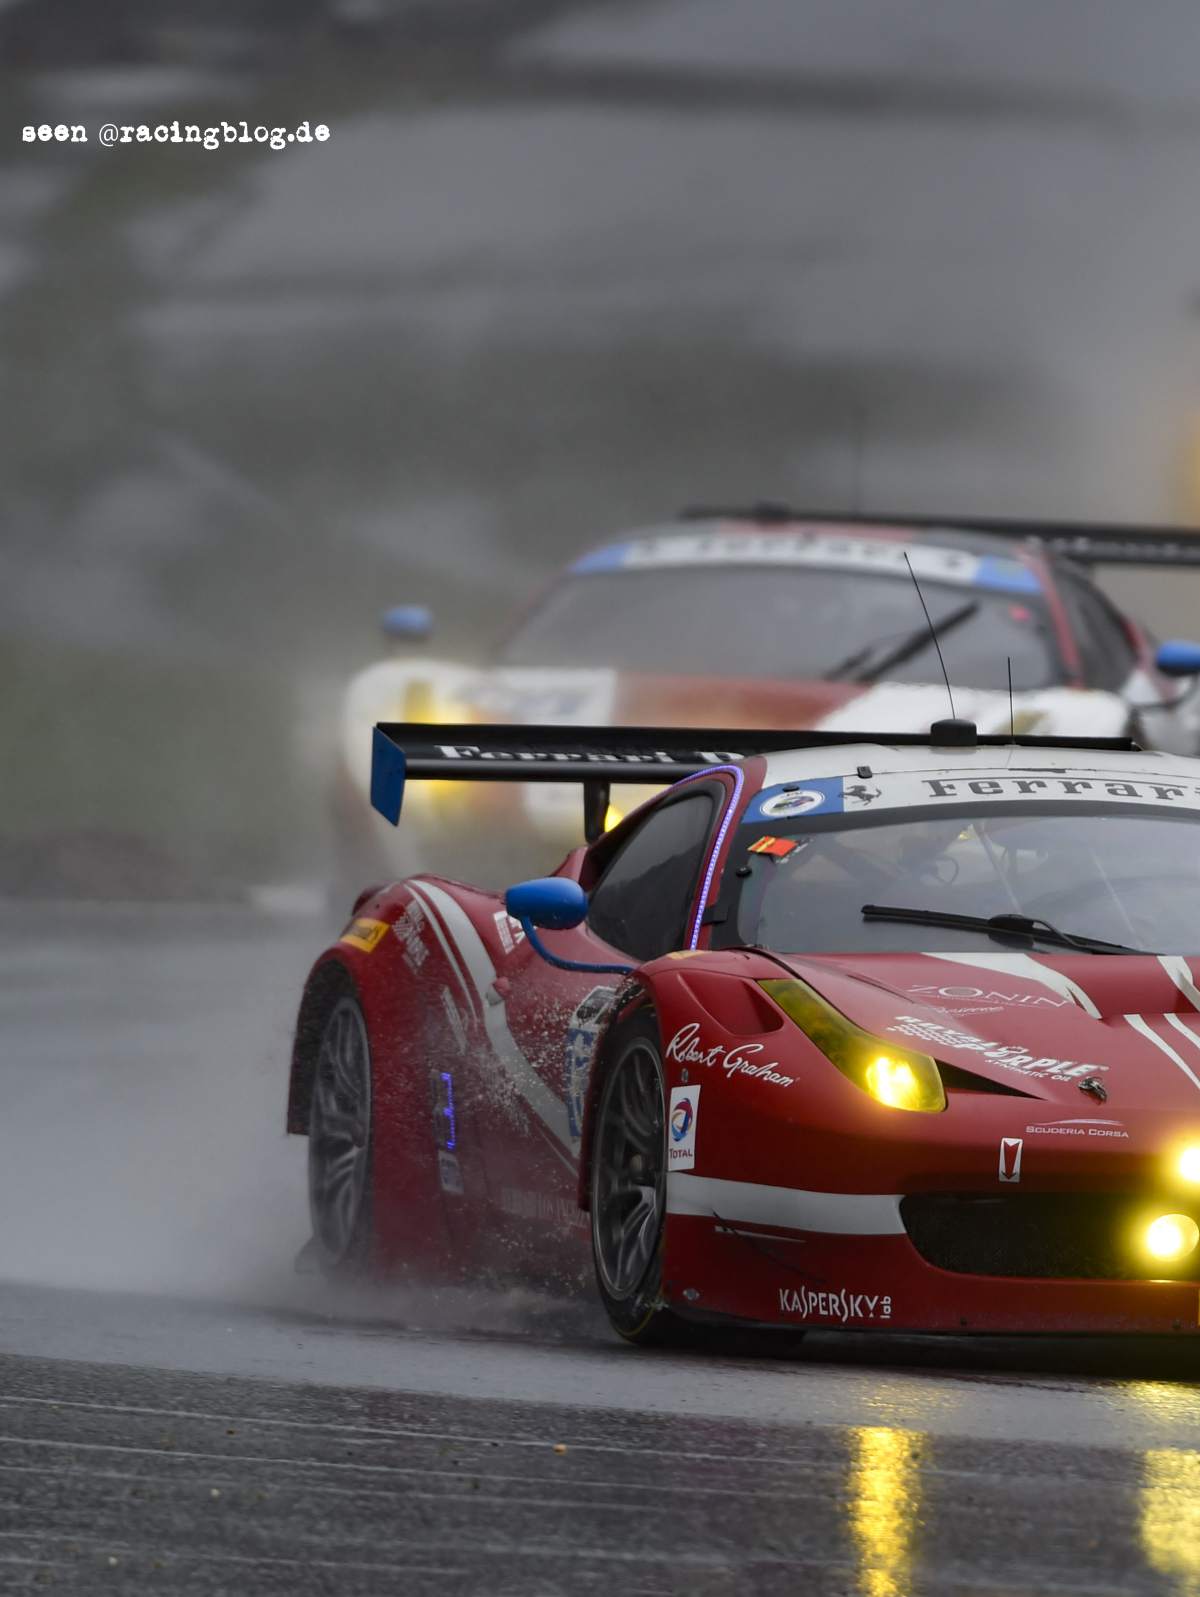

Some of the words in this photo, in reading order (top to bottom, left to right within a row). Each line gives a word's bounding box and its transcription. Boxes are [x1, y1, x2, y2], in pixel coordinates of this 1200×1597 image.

[665, 1022, 725, 1067] Robert
[722, 1043, 794, 1087] Graham
[670, 1149, 693, 1159] TOTAL
[779, 1285, 879, 1323] KASPERSKY
